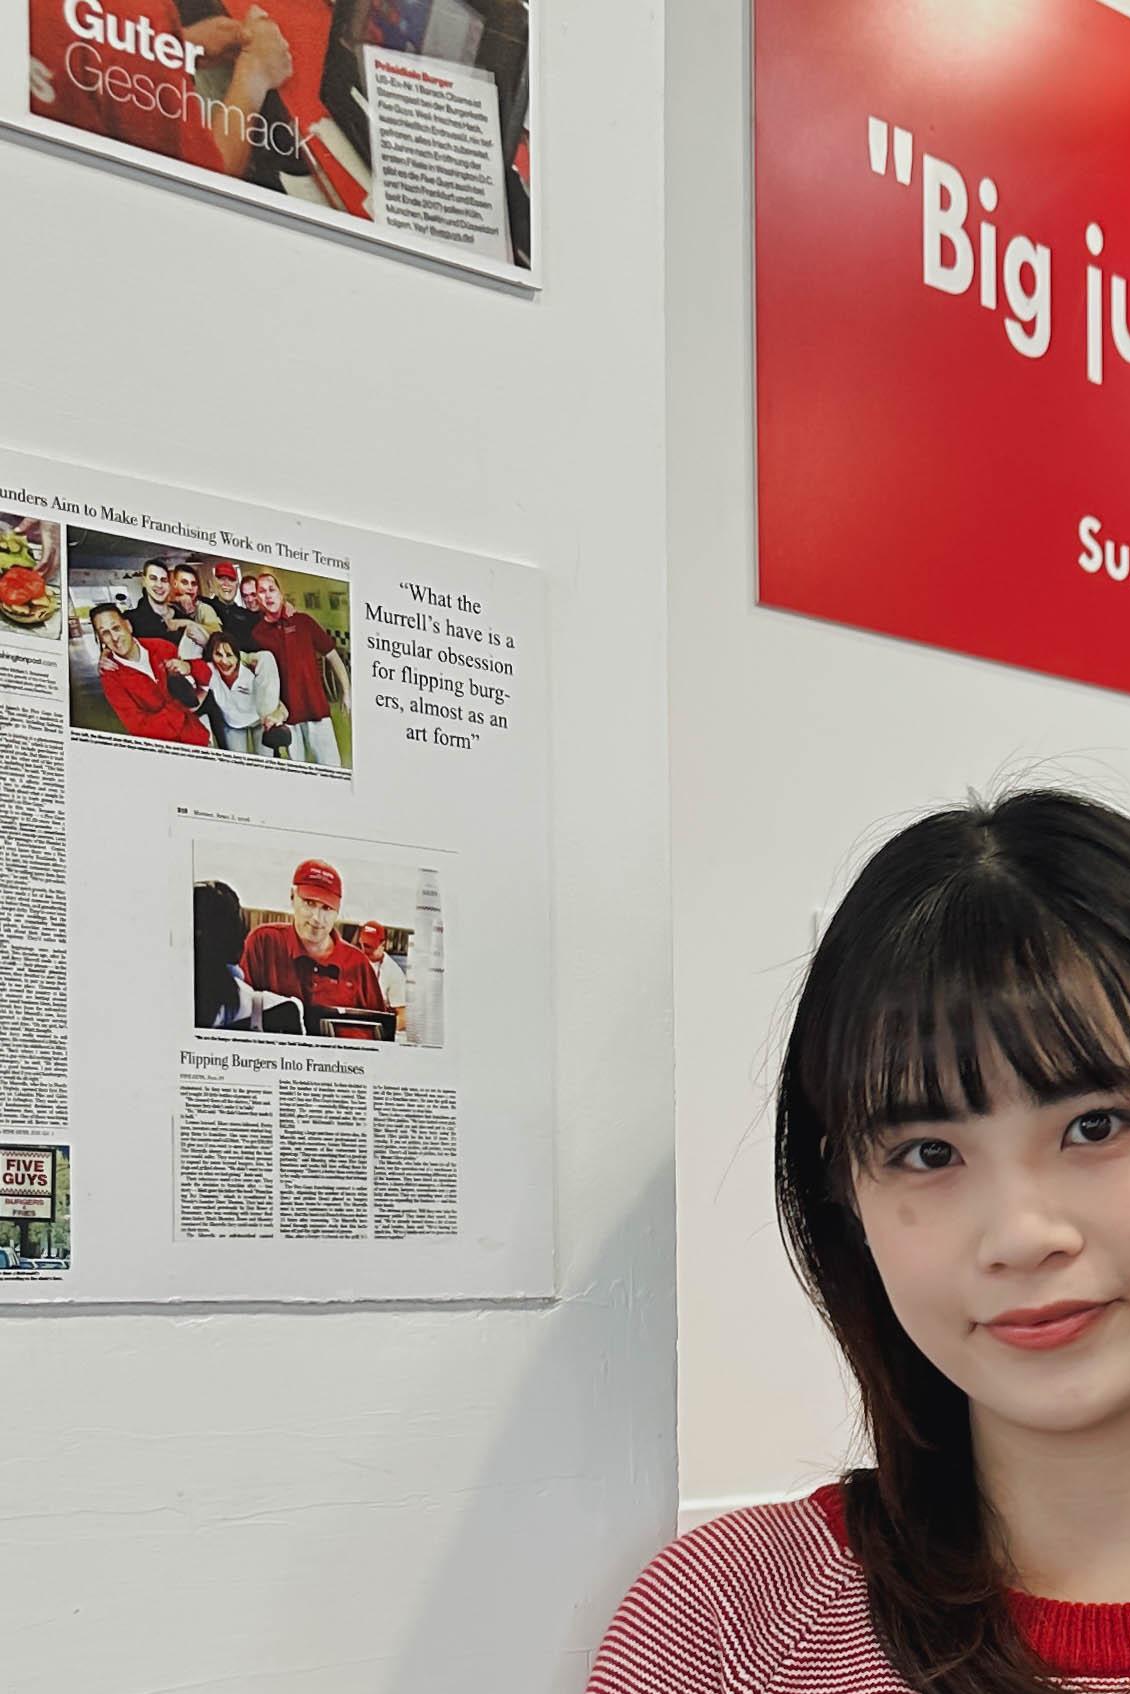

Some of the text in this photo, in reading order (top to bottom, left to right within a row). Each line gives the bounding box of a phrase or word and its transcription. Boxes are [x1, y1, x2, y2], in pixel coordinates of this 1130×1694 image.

[62, 0, 204, 75] Guter
[66, 41, 319, 169] Geschmack
[868, 114, 1051, 358] "Big
[51, 495, 80, 514] Aim
[84, 503, 97, 517] to
[101, 505, 138, 526] Make
[141, 514, 218, 546] Franchising
[220, 530, 254, 550] Work
[257, 541, 272, 554] on
[275, 541, 309, 562] Their
[312, 549, 351, 571] Terms
[399, 581, 482, 615] “What the
[365, 602, 515, 649] Murrell’s have is a
[367, 632, 514, 676] singular obsession
[372, 660, 511, 705] for flipping burg-
[375, 693, 508, 729] ers, almost as an
[406, 726, 480, 750] art form”
[180, 1051, 365, 1075] Flipping Burgers Into Franchises
[2, 1172, 48, 1187] GUYS
[6, 1159, 45, 1173] FIVE
